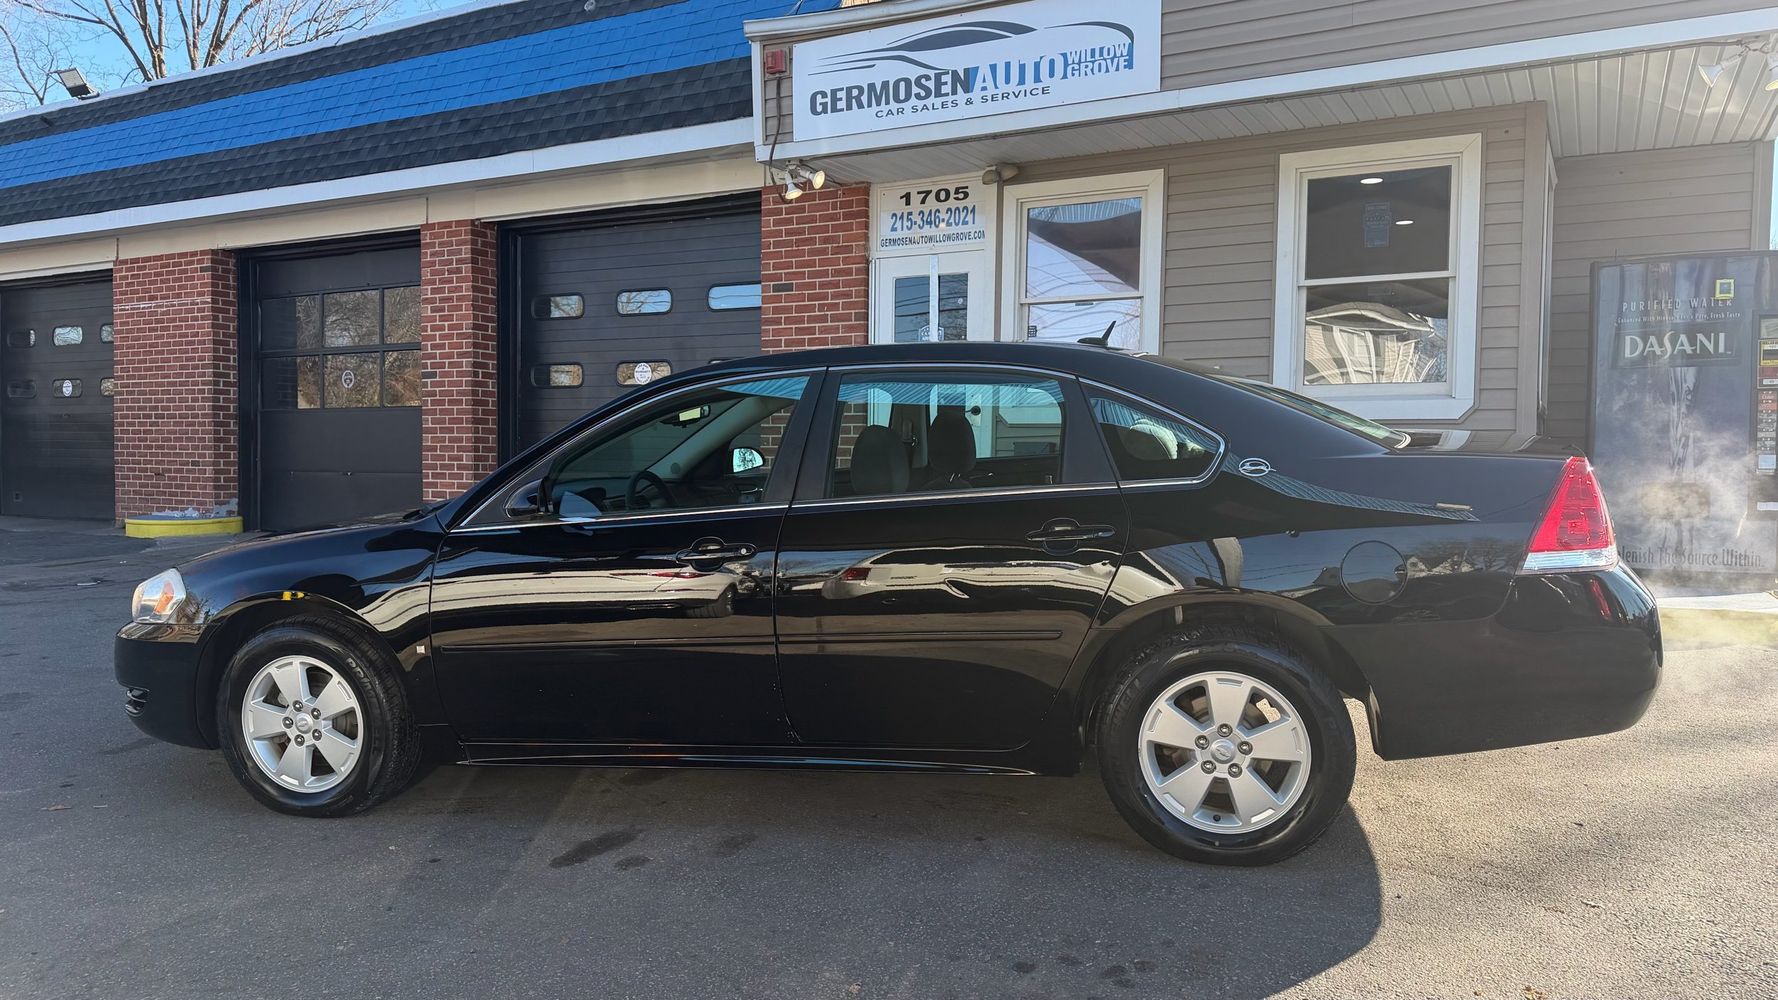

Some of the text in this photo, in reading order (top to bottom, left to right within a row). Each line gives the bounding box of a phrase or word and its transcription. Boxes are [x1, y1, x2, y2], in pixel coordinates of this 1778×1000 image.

[1066, 42, 1130, 64] WILLOW
[1066, 56, 1130, 79] GROVE
[809, 54, 1064, 116] GERMOSEN AUTO
[875, 86, 1051, 118] CAR SALES & SERVICE
[899, 185, 970, 207] 1705
[890, 204, 977, 233] 215-346-2021
[1622, 296, 1733, 312] PURIFIED WATER
[1624, 330, 1726, 359] DASANI
